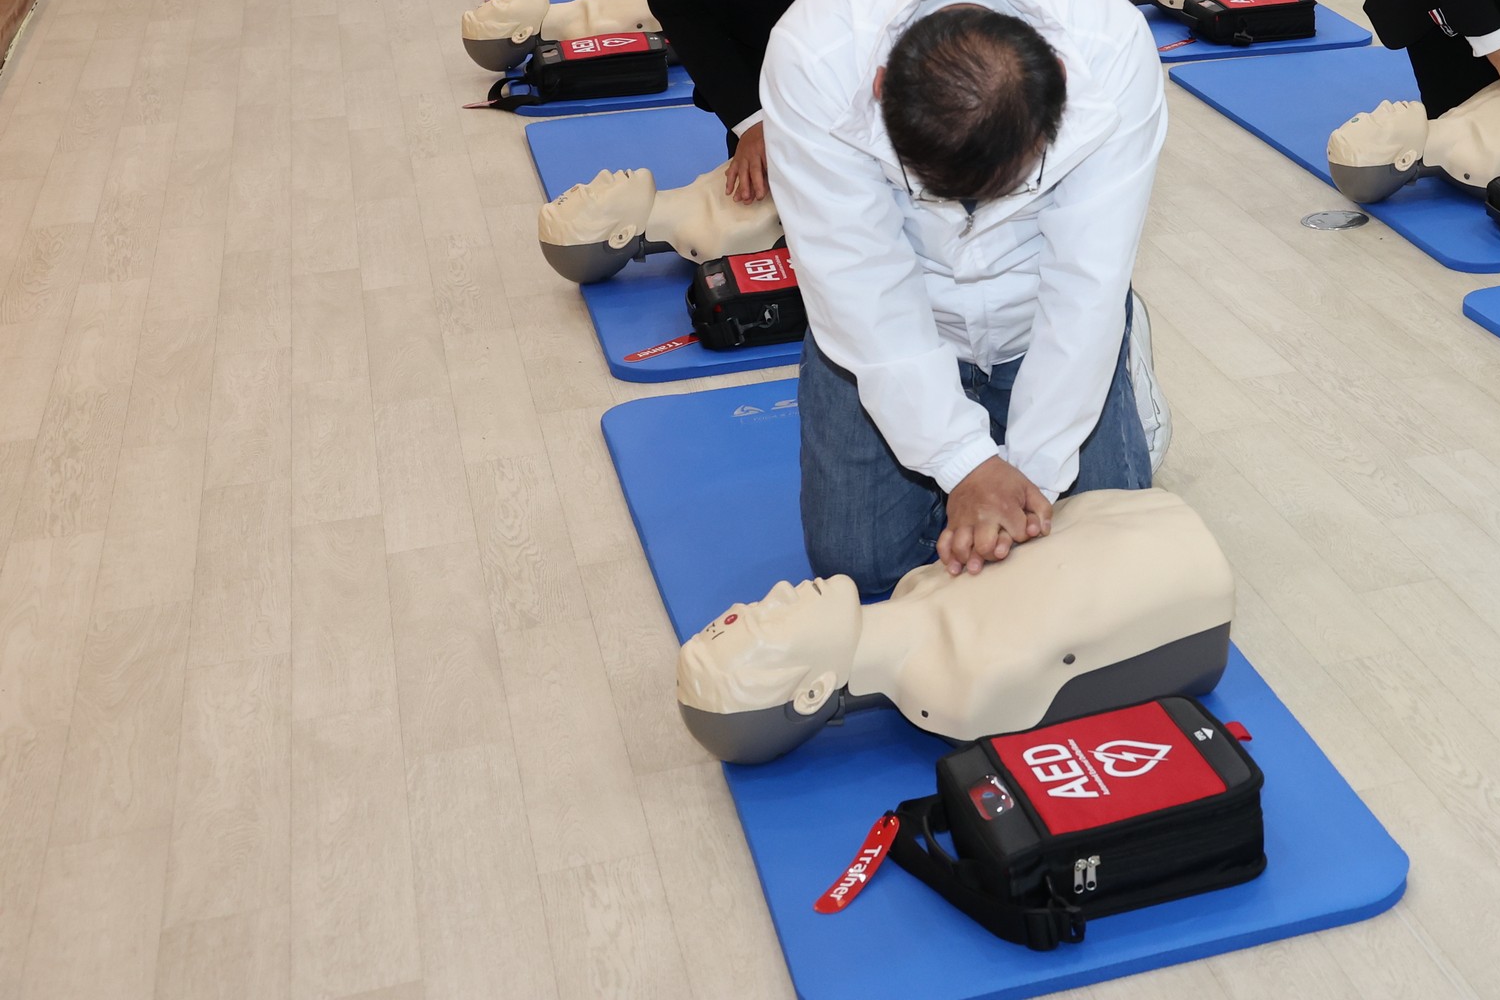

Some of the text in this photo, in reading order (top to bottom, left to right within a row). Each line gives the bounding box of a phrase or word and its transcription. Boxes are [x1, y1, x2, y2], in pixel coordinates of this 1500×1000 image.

[571, 40, 596, 52] AED
[745, 258, 780, 281] AED
[637, 341, 683, 358] Trainer
[1022, 743, 1099, 798] AED
[830, 845, 882, 900] Trainer
